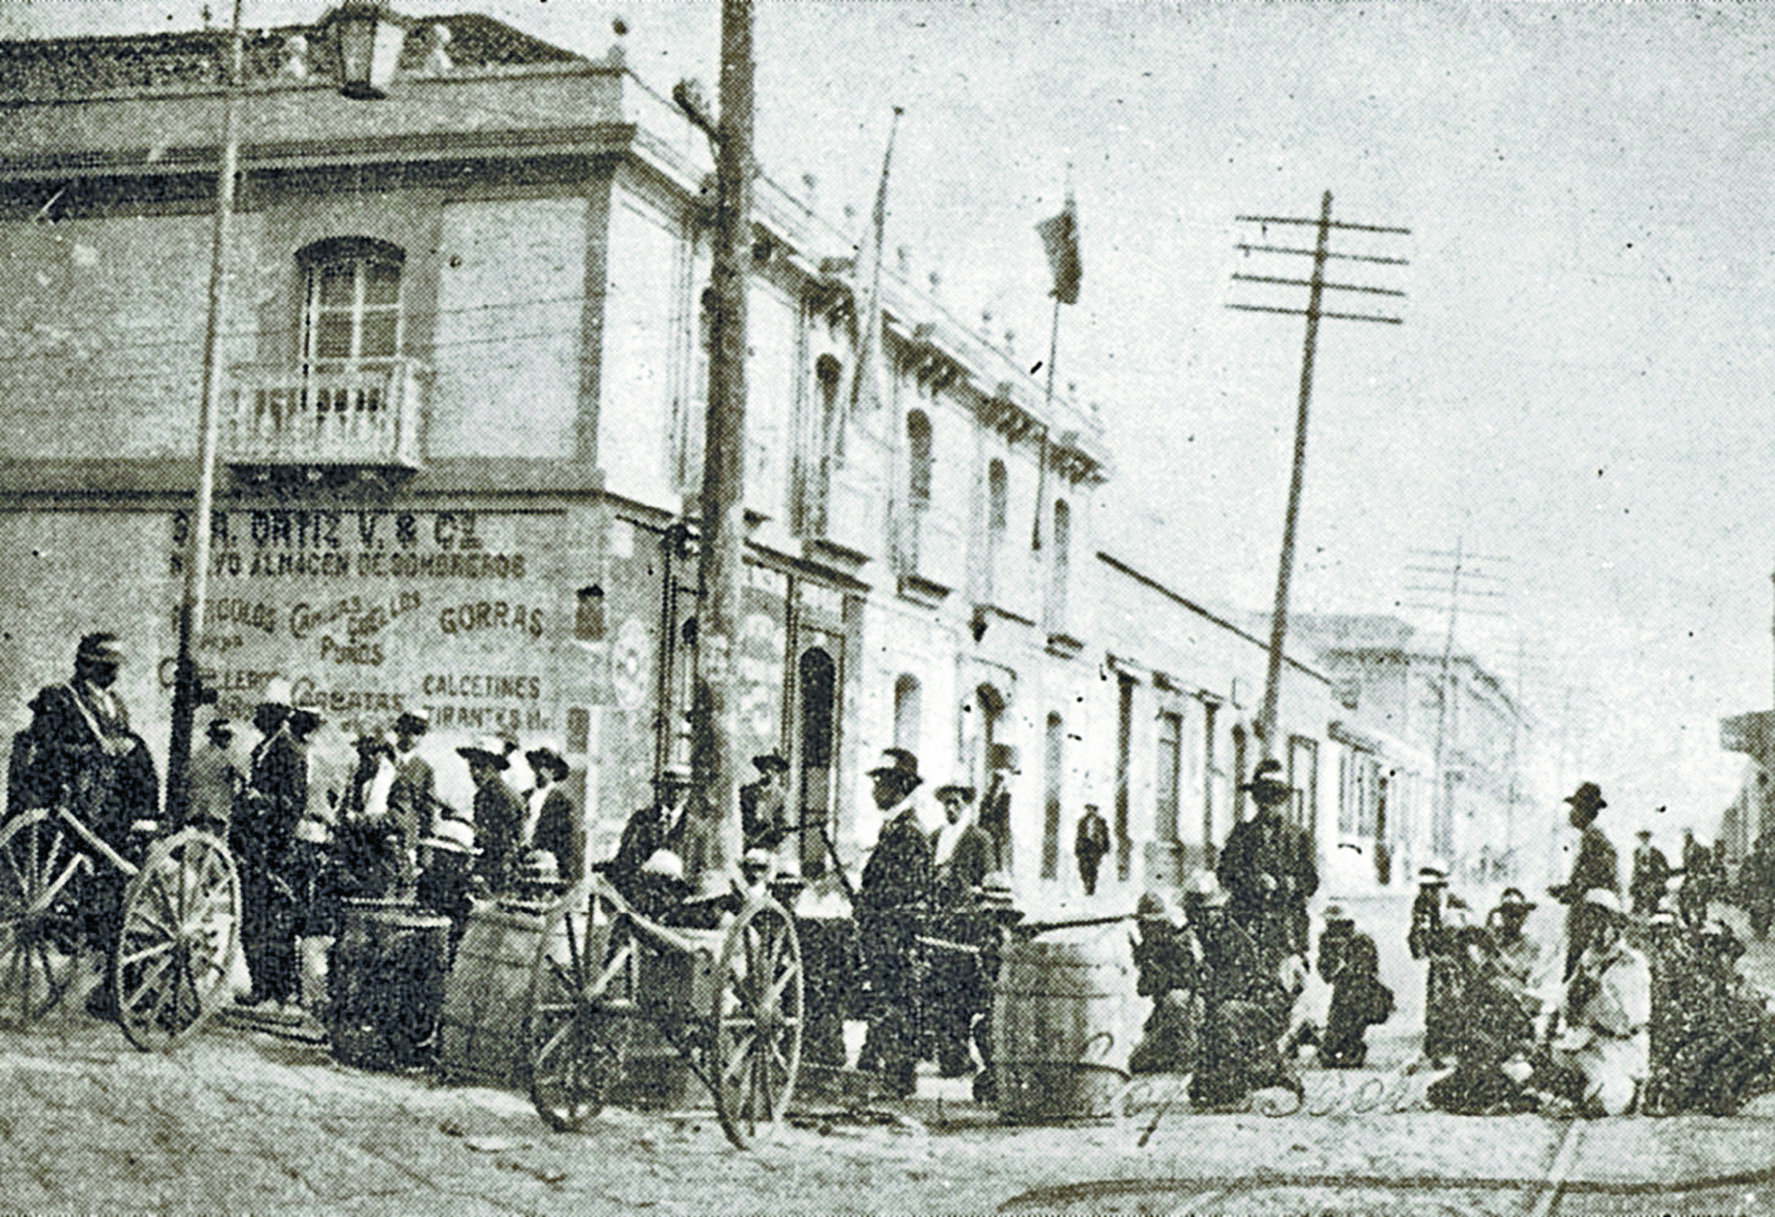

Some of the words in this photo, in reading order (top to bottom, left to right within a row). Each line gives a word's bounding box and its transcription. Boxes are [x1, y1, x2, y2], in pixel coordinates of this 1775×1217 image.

[251, 508, 341, 549] ORTIZ
[250, 551, 349, 578] ALMACEN
[358, 553, 388, 578] DE
[390, 552, 527, 580] SOMBREROS
[439, 600, 544, 639] GORRAS
[423, 673, 541, 702] CALCETINES
